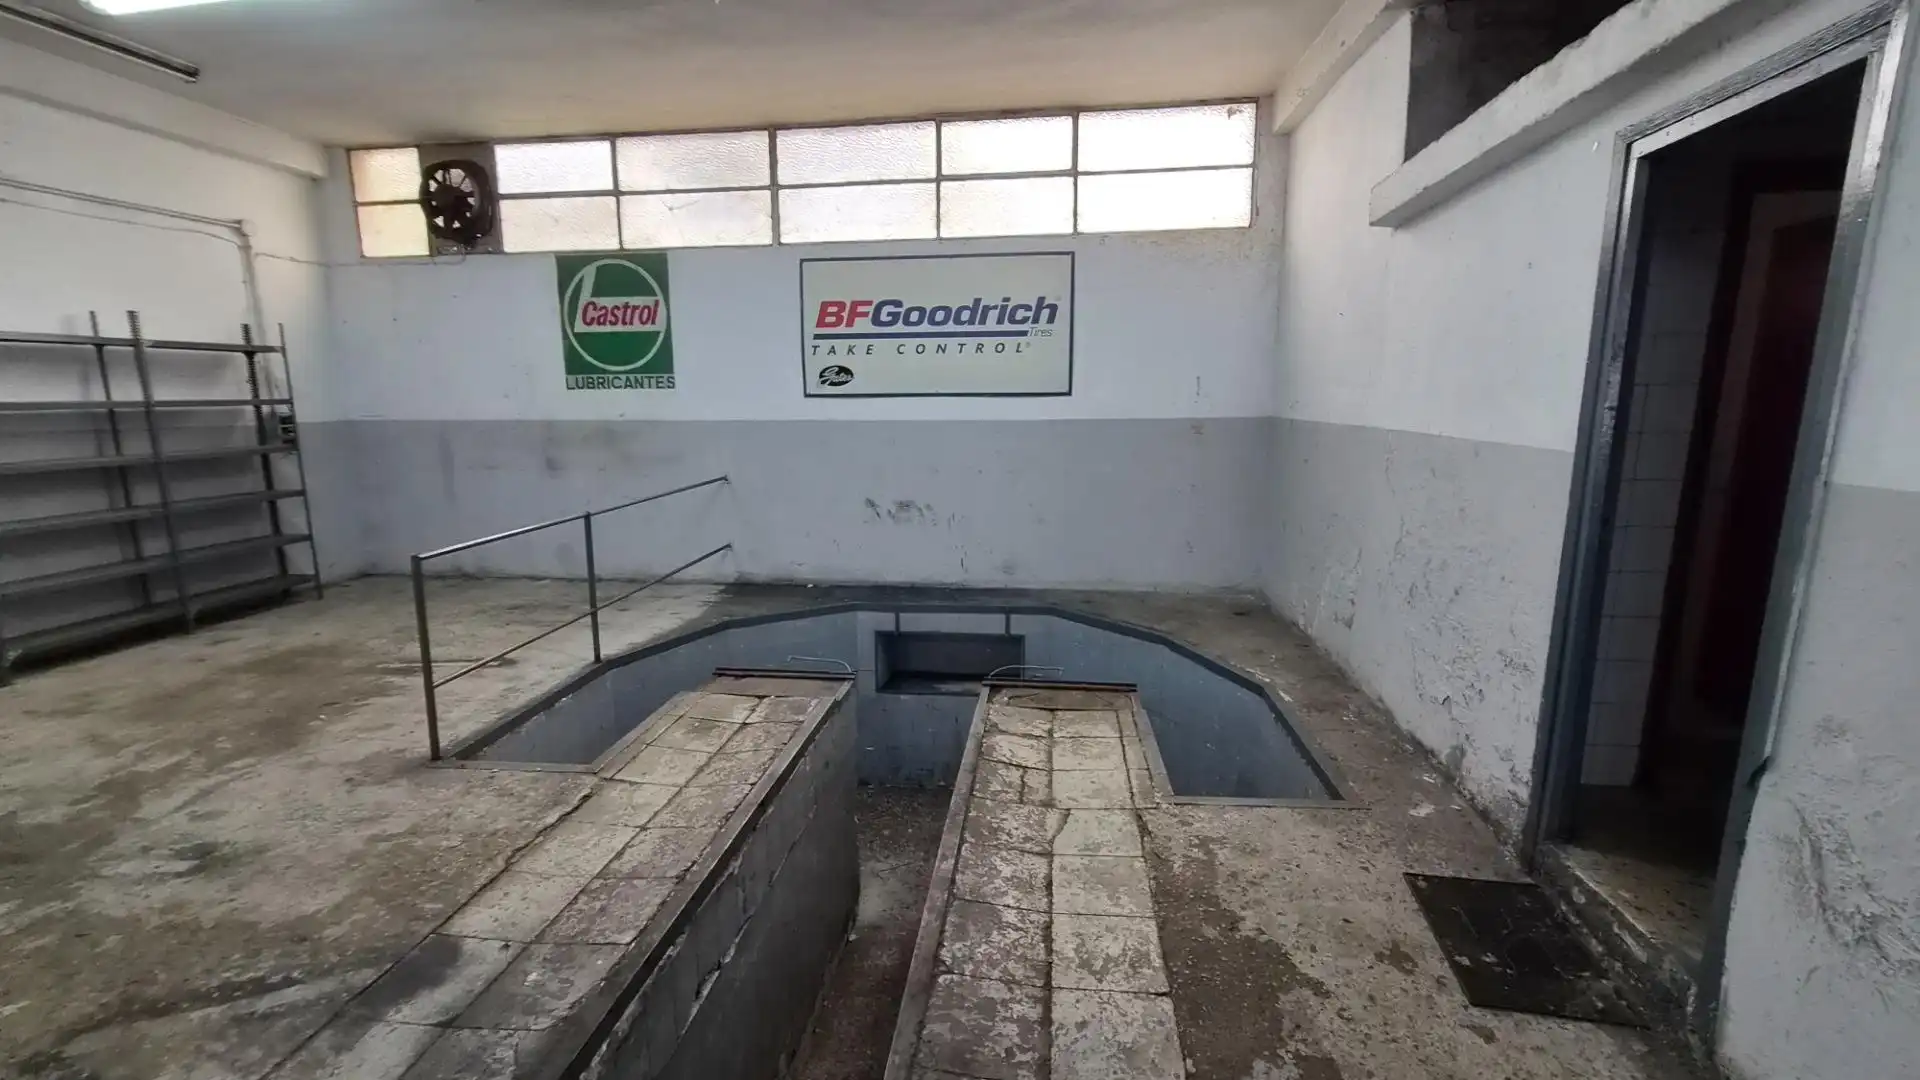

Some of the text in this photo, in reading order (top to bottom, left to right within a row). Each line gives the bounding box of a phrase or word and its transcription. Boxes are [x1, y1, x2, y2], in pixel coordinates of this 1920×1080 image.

[581, 299, 660, 327] Castrol
[815, 296, 1059, 329] BFGoodrich
[1028, 326, 1053, 338] Tires
[811, 342, 1023, 356] TAKE CONTROL
[565, 375, 676, 390] LUBRICANTES
